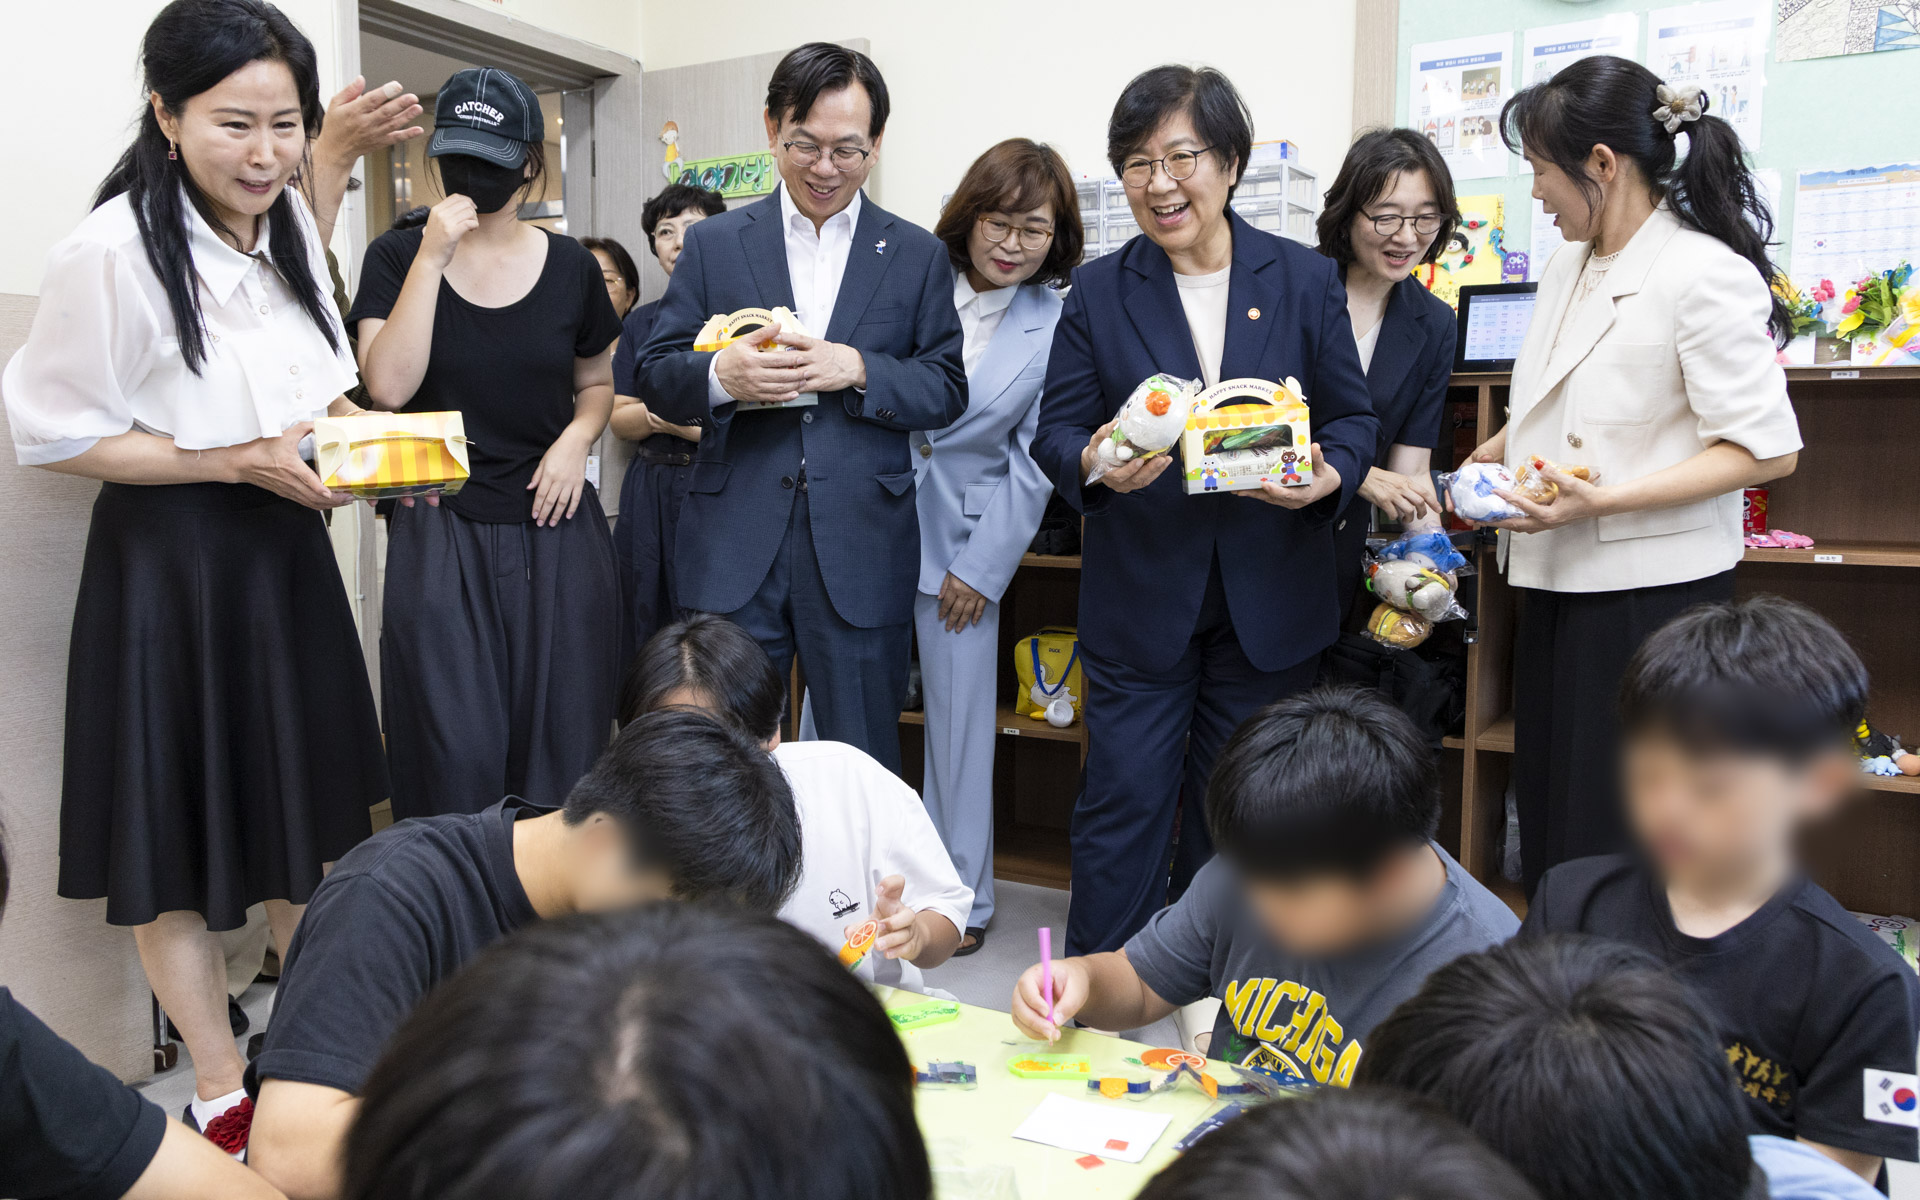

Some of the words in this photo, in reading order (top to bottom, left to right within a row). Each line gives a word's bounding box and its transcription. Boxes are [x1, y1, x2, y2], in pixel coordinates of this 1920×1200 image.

[454, 101, 504, 122] CATCHER
[676, 154, 772, 193] 이야기방
[728, 317, 741, 328] HAPPY
[755, 313, 773, 323] MARKET
[1208, 387, 1227, 400] HAPPY
[1227, 383, 1248, 392] SNACK
[1248, 384, 1274, 395] MARKET
[1225, 977, 1363, 1089] MICHIGA
